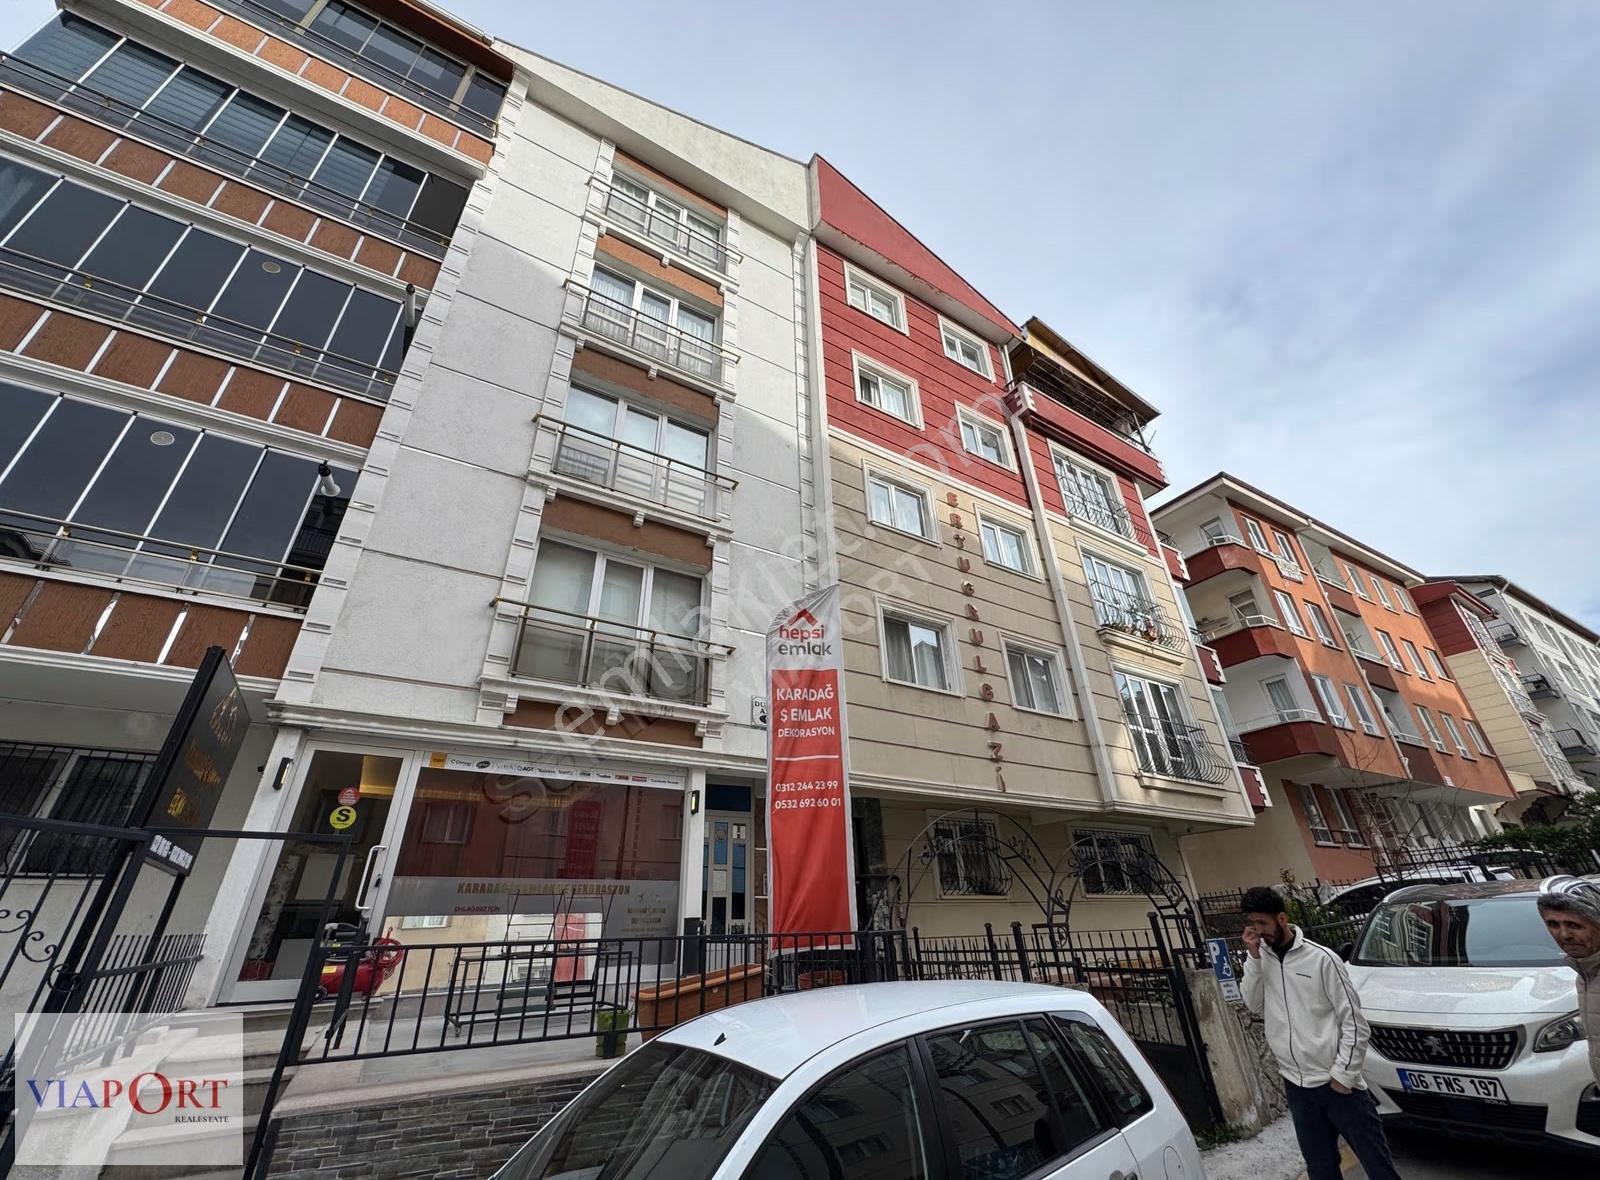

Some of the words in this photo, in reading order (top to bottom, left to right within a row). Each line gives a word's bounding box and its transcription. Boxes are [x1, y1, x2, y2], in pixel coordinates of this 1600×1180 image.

[779, 625, 825, 642] hepsi
[778, 642, 832, 655] emlak
[776, 684, 834, 701] KARADAĞ
[780, 709, 788, 723] Ş
[791, 707, 832, 722] EMLAK
[778, 726, 835, 738] DEKORASYON
[775, 782, 795, 792] 0312
[797, 781, 813, 791] 244
[815, 780, 826, 790] 23
[827, 780, 838, 790] 99
[775, 799, 798, 809] 0532
[799, 798, 816, 808] 692
[817, 798, 829, 807] 60
[831, 797, 841, 807] 01
[1408, 1072, 1429, 1089] 06
[1432, 1075, 1465, 1093] FNS
[1469, 1079, 1498, 1097] 197
